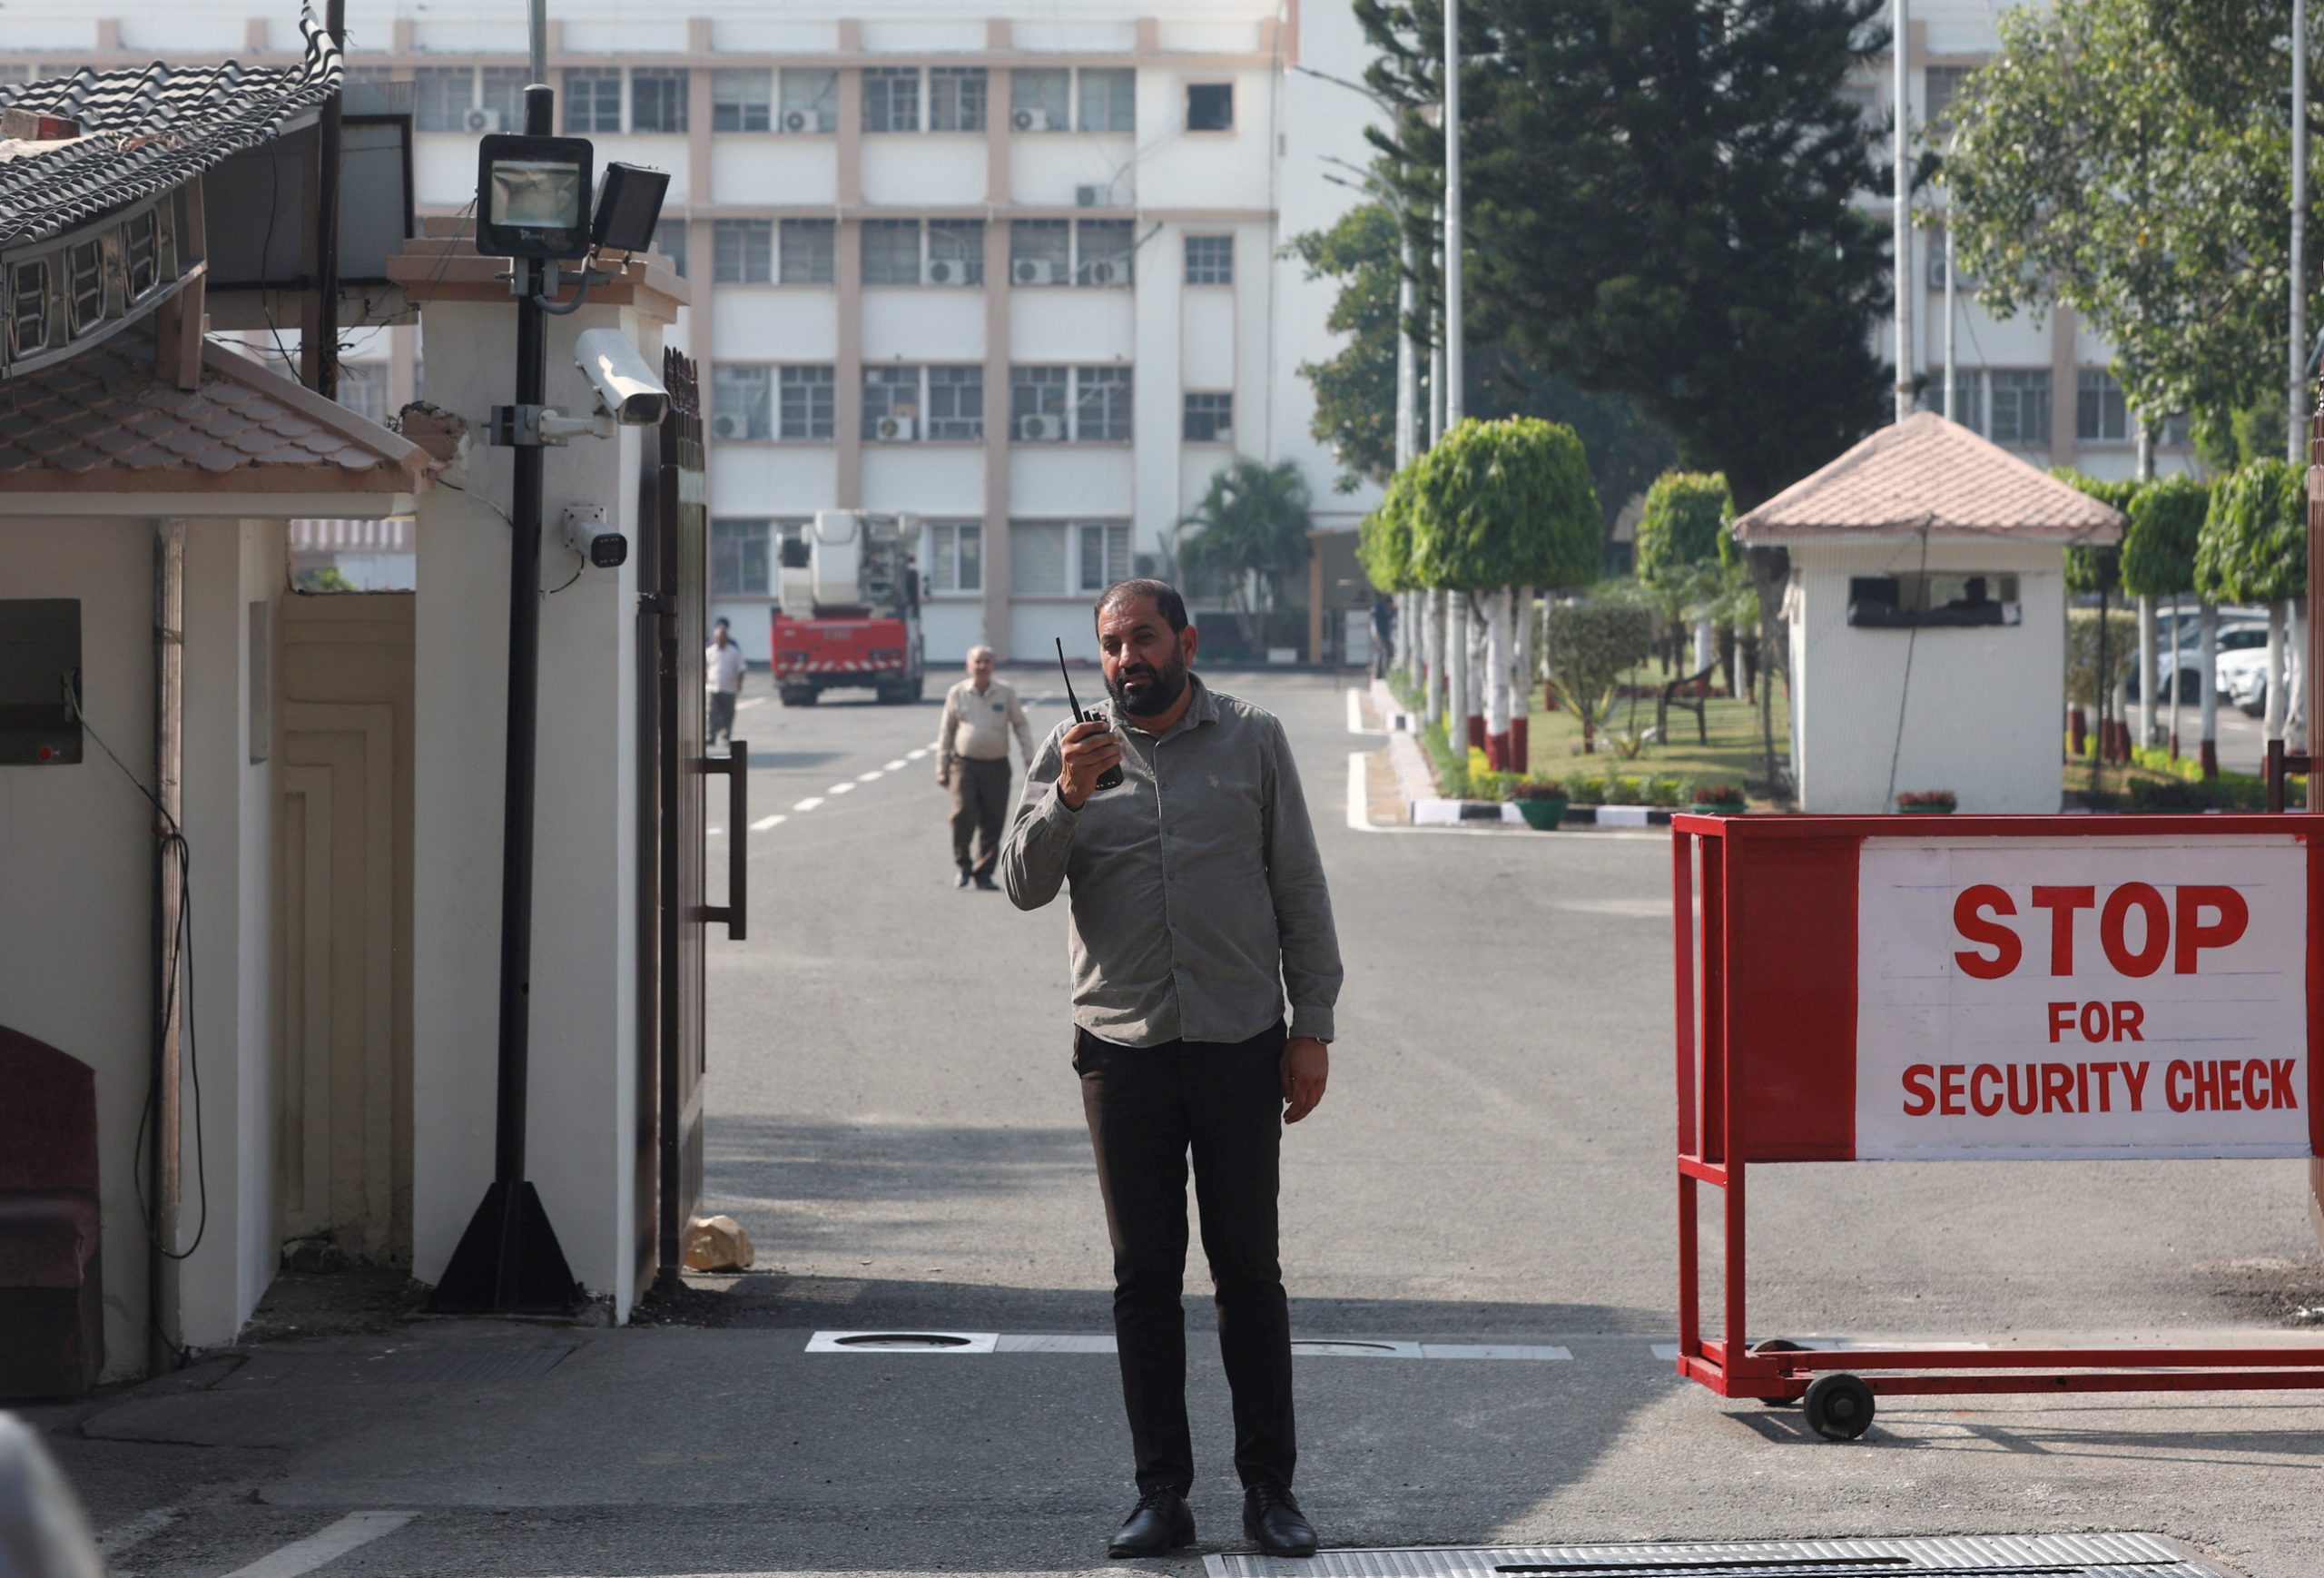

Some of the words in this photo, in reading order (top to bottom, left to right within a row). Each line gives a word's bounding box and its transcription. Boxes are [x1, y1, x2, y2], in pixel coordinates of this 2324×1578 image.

[1954, 882, 2249, 980] STOP
[2048, 1001, 2144, 1043] FOR
[1902, 1061, 2150, 1118] SECURITY
[2165, 1059, 2299, 1113] CHECK
